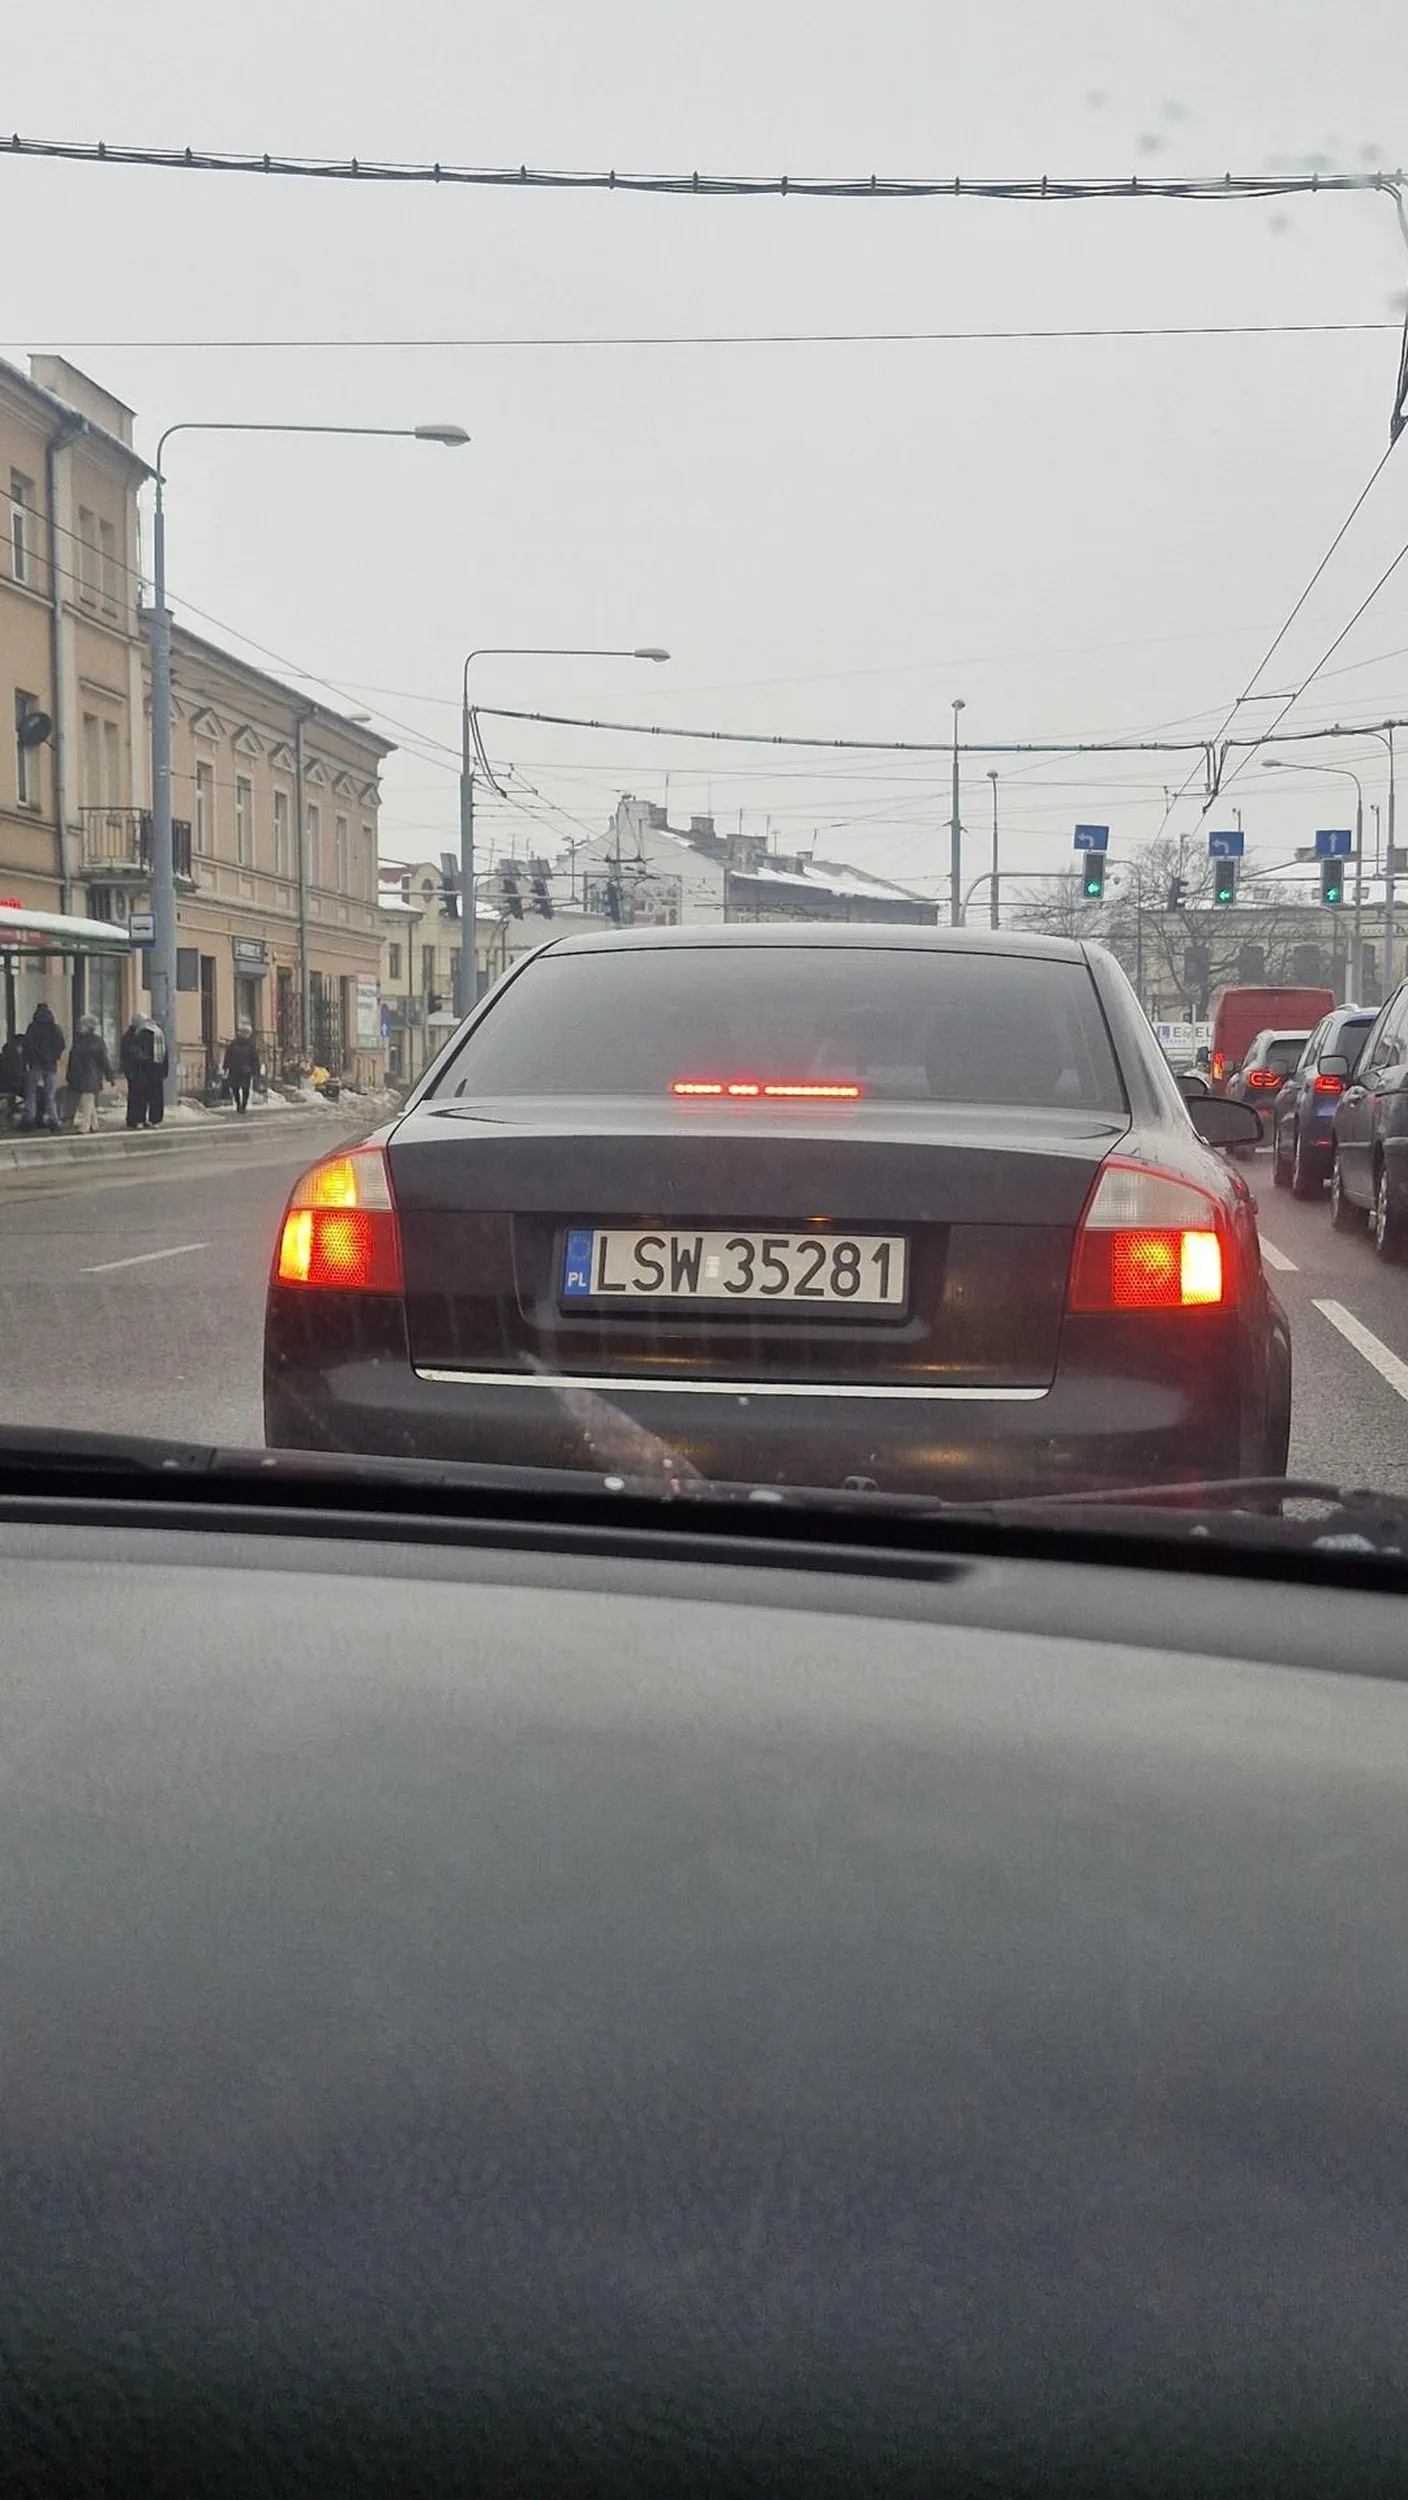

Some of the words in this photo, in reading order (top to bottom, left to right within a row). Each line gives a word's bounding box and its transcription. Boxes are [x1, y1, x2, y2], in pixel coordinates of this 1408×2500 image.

[568, 1272, 587, 1287] PL
[597, 1236, 704, 1293] LSW
[723, 1238, 891, 1298] 35281
